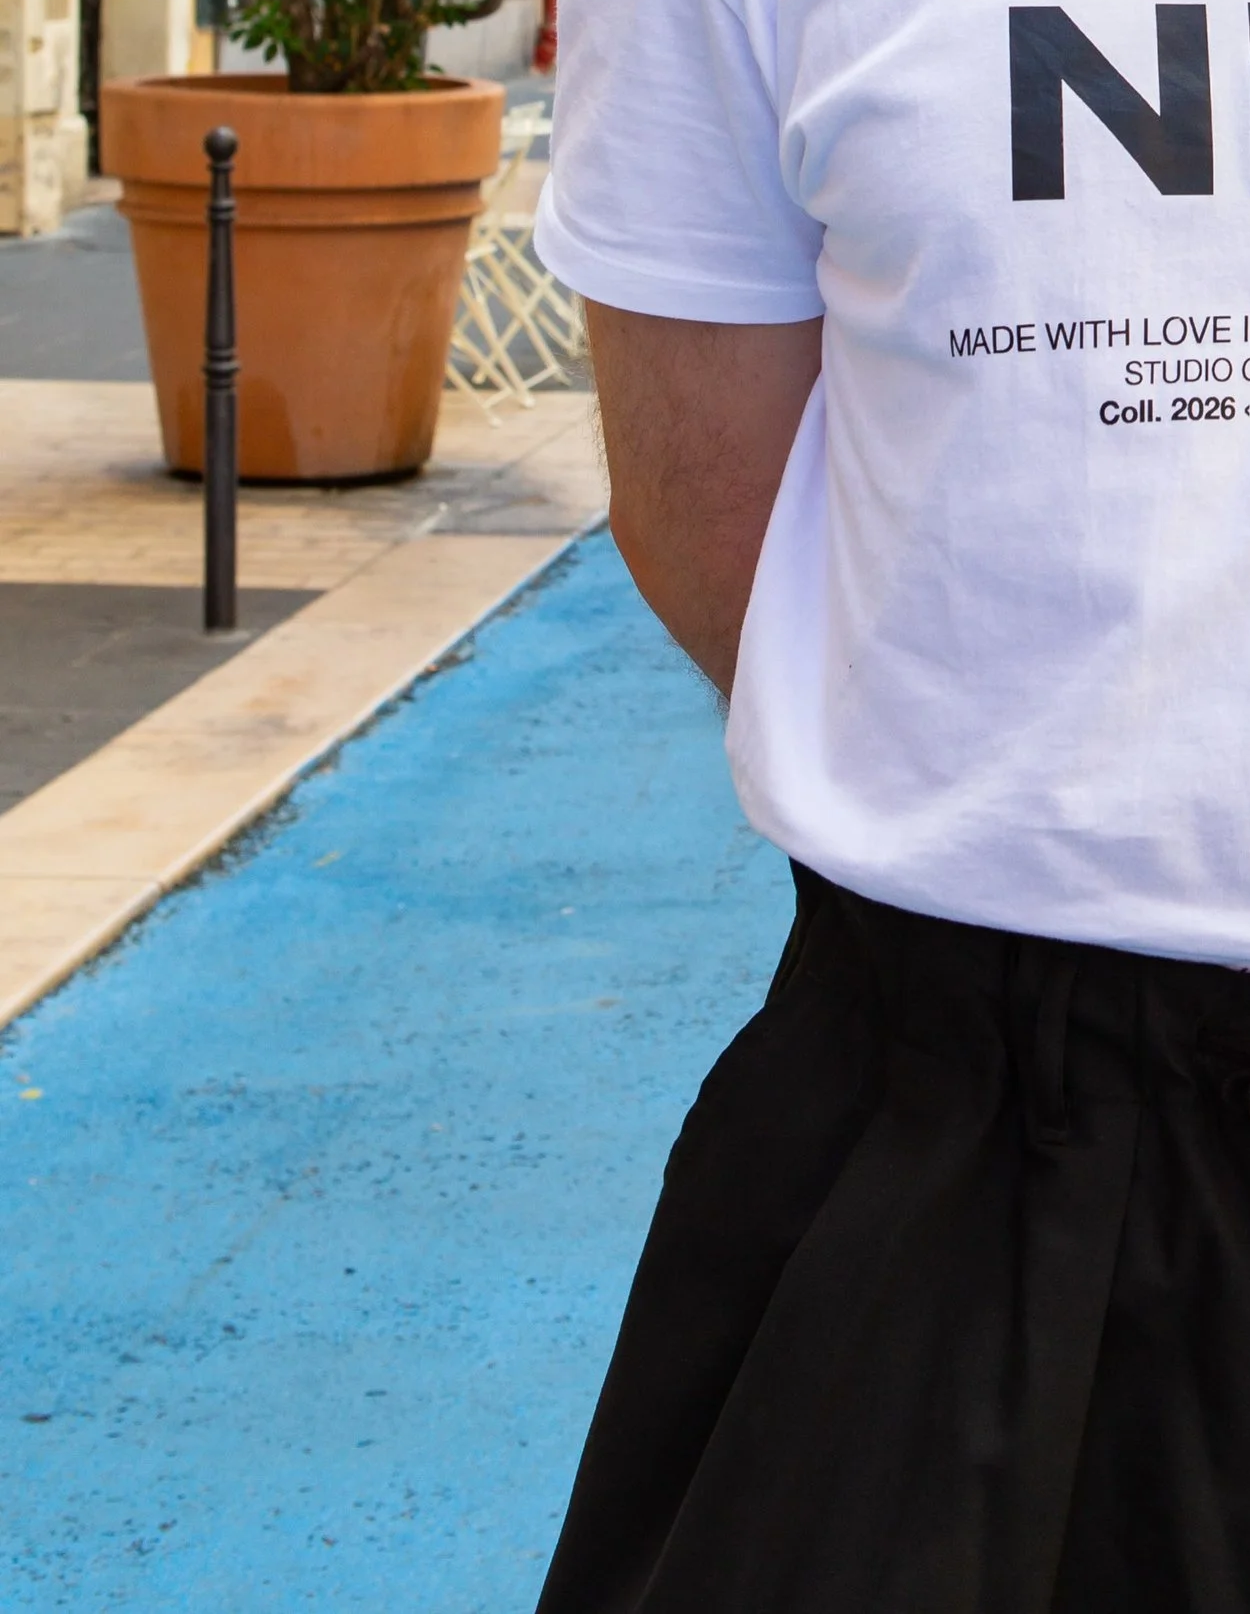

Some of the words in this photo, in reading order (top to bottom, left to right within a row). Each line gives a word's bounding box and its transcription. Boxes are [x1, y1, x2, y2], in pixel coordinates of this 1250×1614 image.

[949, 323, 1037, 358] MADE
[1044, 318, 1130, 351] WITH
[1143, 315, 1232, 346] LOVE
[1124, 357, 1233, 386] STUDIO
[1099, 399, 1162, 426] Coll.
[1171, 396, 1236, 421] 2026
